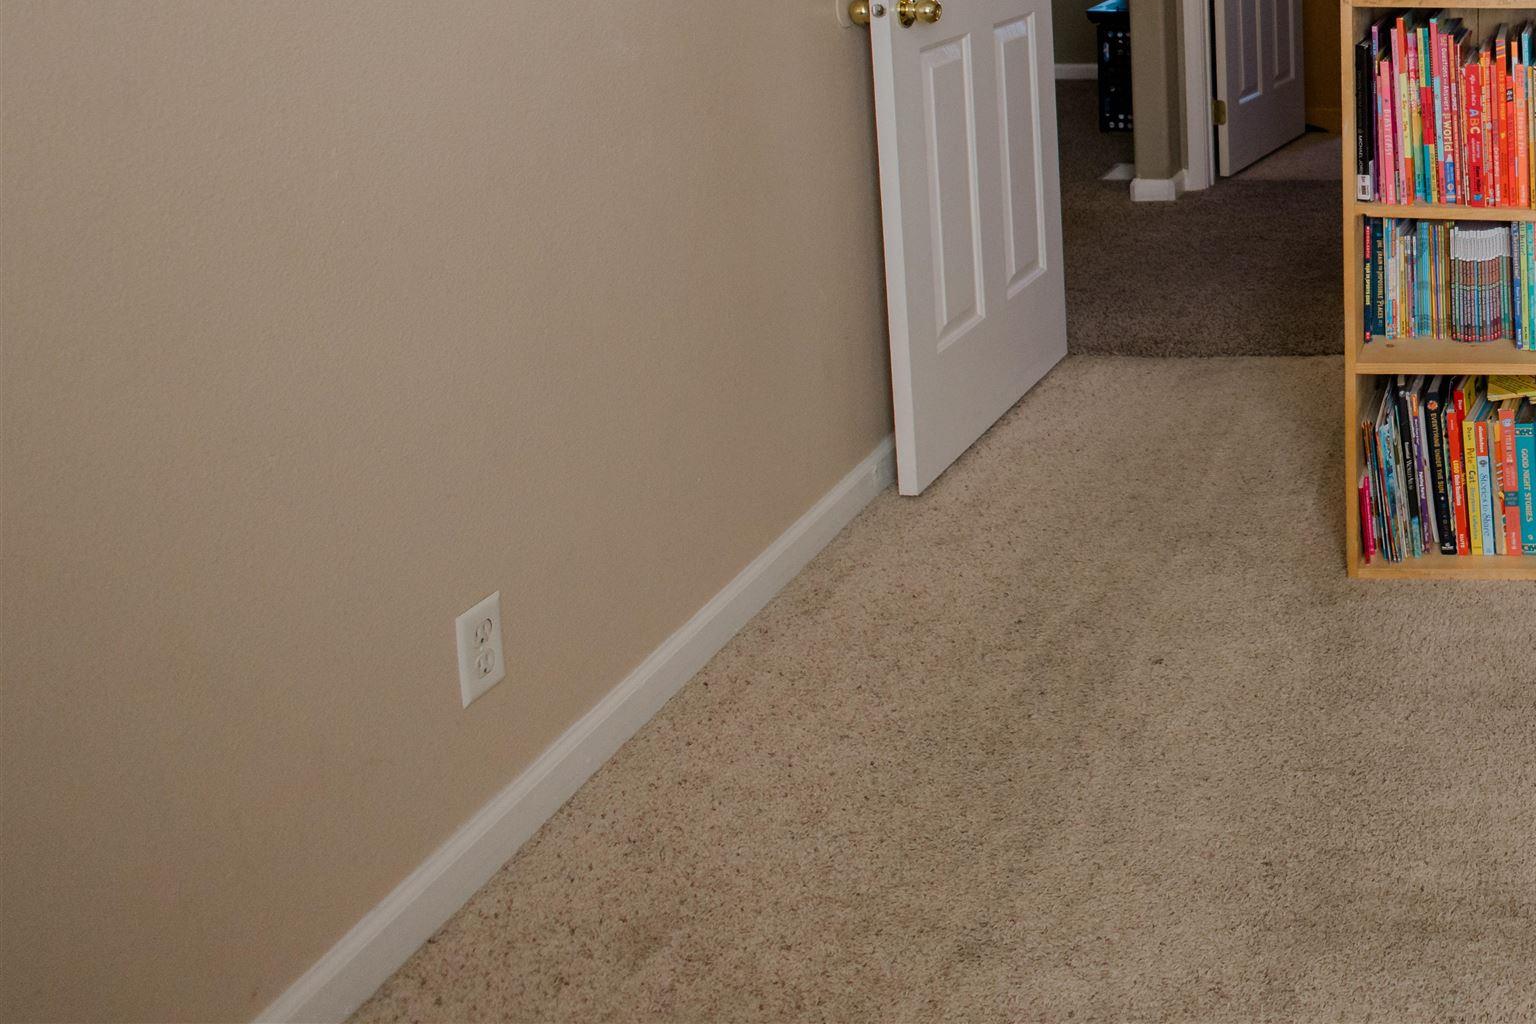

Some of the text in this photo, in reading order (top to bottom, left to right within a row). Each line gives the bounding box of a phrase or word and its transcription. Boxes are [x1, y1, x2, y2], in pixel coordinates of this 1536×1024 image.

[1441, 48, 1449, 78] Questions
[1443, 120, 1454, 151] world
[1430, 413, 1440, 447] EVERYTHING
[1480, 472, 1489, 502] Stories
[1521, 448, 1533, 522] GOOD NIGHT STORIES
